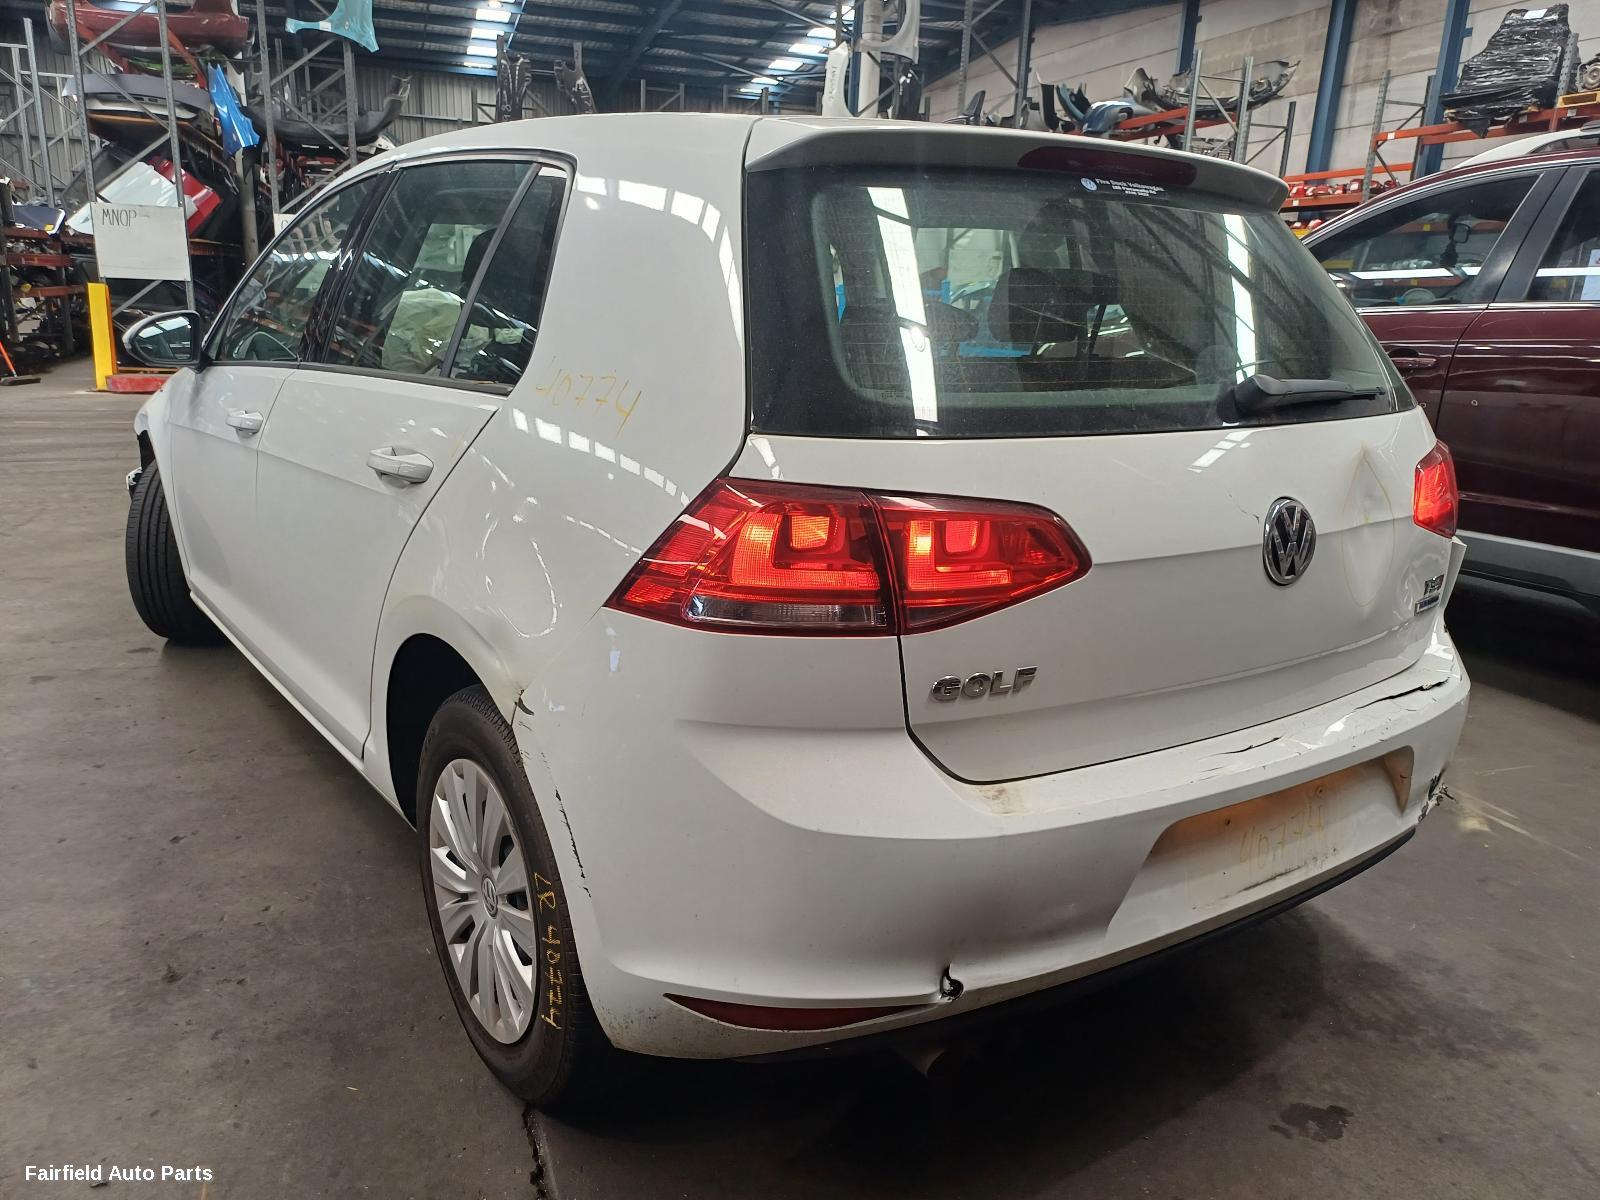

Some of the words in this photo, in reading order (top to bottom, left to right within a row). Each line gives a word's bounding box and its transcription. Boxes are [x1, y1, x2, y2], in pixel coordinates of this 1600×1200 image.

[102, 208, 137, 227] MNOP
[535, 359, 642, 437] 40774
[931, 666, 1038, 702] GOLF
